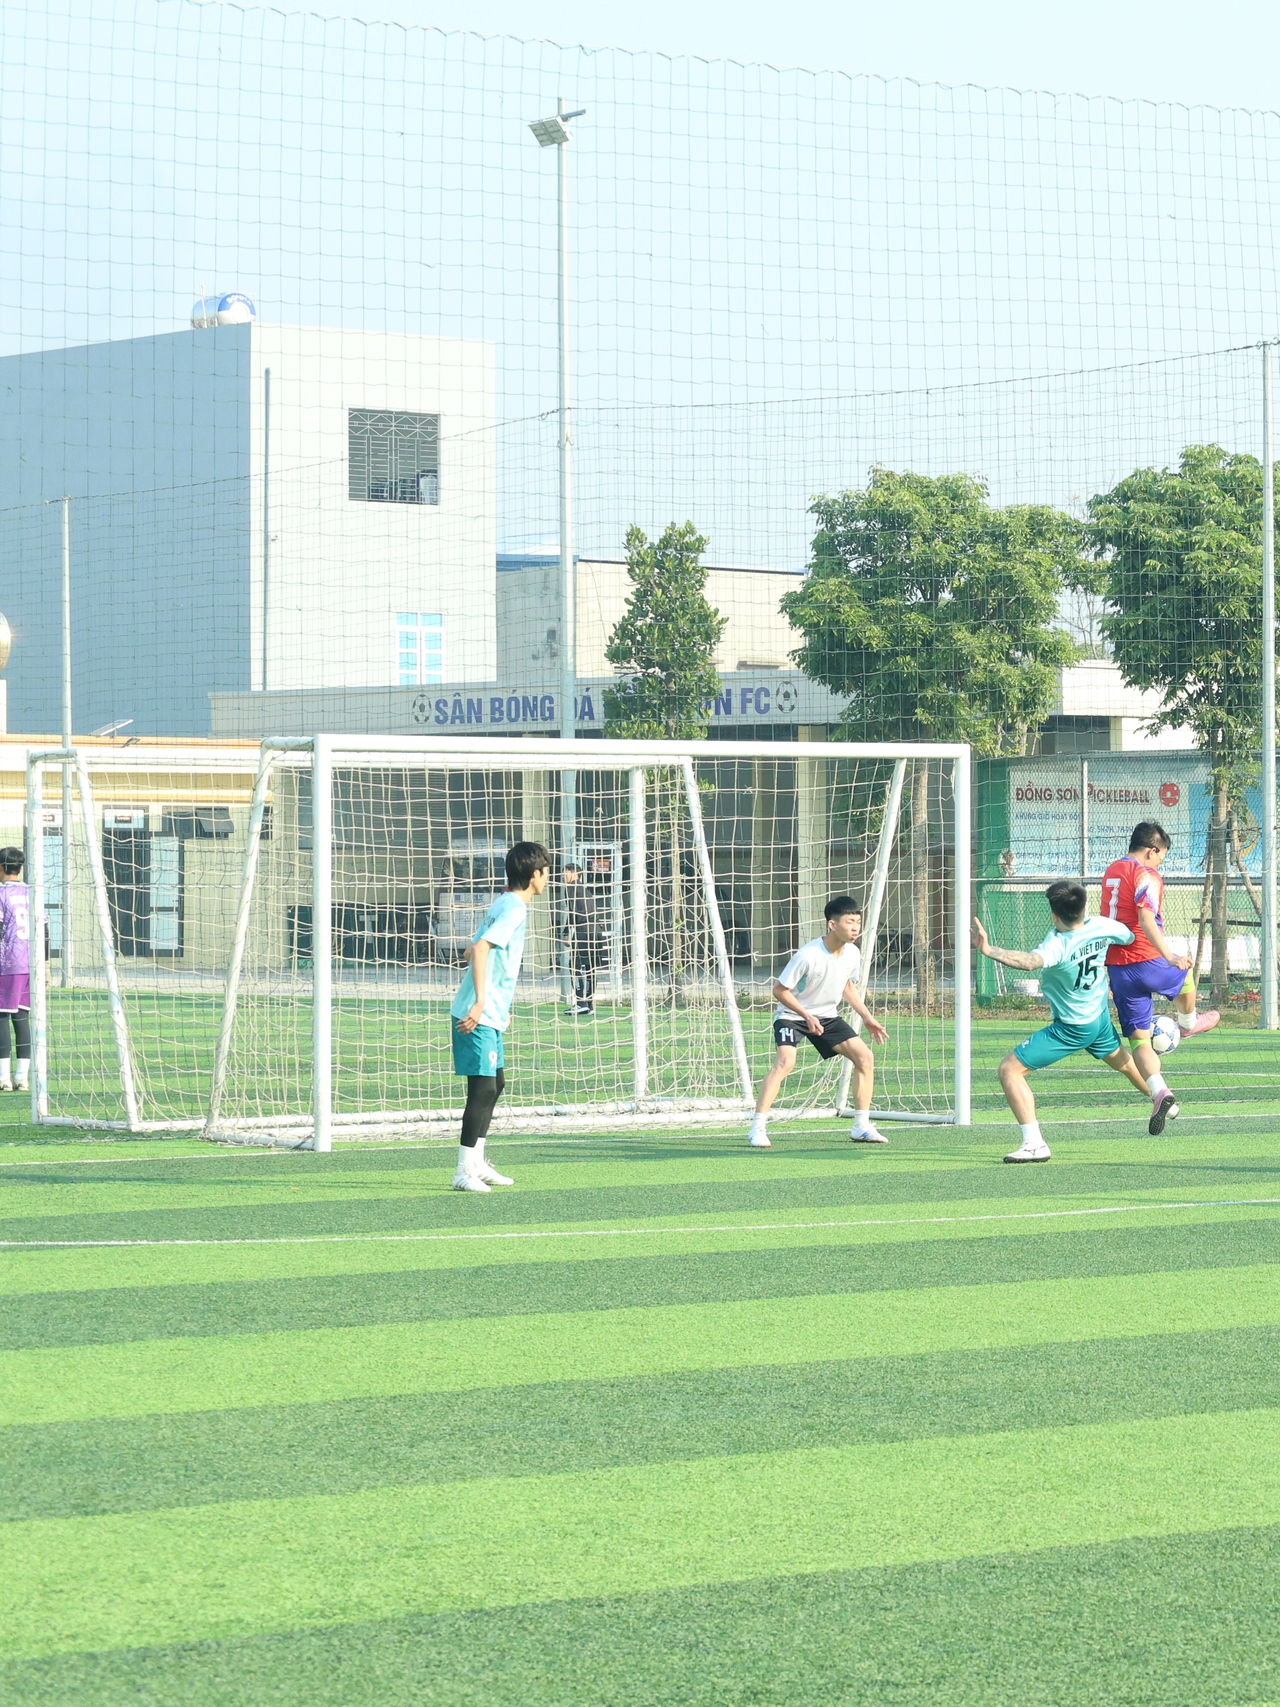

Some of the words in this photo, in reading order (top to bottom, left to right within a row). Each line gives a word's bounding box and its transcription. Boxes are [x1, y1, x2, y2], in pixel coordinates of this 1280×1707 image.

[434, 692, 483, 725] SÂN
[490, 688, 555, 723] BÓNG
[741, 686, 771, 715] FC
[1106, 878, 1121, 920] 7
[1073, 954, 1099, 991] 15
[779, 1027, 794, 1042] 14
